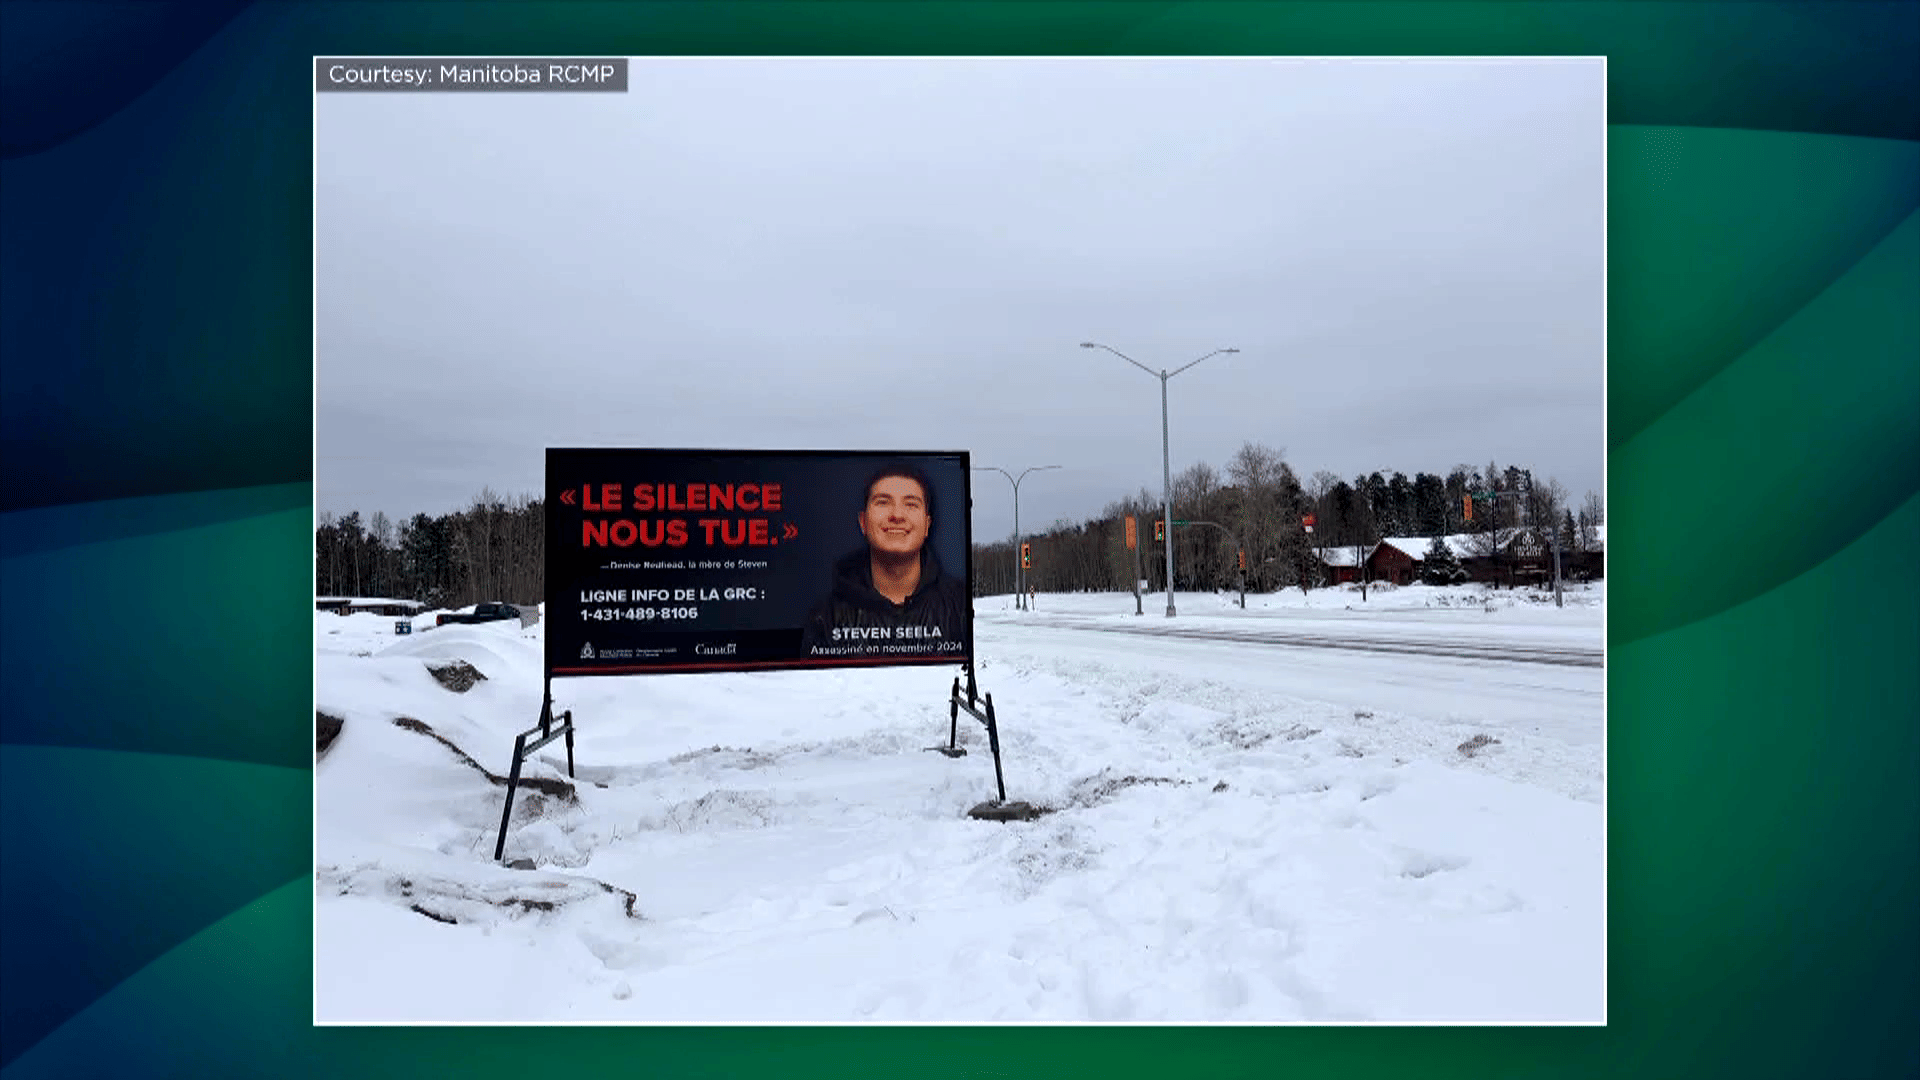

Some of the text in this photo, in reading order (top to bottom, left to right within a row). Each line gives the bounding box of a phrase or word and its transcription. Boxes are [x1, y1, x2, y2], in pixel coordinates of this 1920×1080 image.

[633, 483, 783, 511] SILENCE
[582, 519, 689, 547] NOUS
[688, 560, 697, 569] la
[699, 559, 722, 569] mère
[723, 559, 736, 569] de
[738, 559, 768, 569] Steven
[580, 589, 628, 602] LIGNE
[631, 588, 670, 602] INFO
[674, 588, 696, 601] DE
[700, 587, 720, 601] LA
[723, 587, 757, 600] GRC
[580, 607, 699, 621] 1-431-489-8106
[832, 625, 942, 641] STEVEN SEELA
[810, 641, 963, 655] Assassiné en novembre 2024
